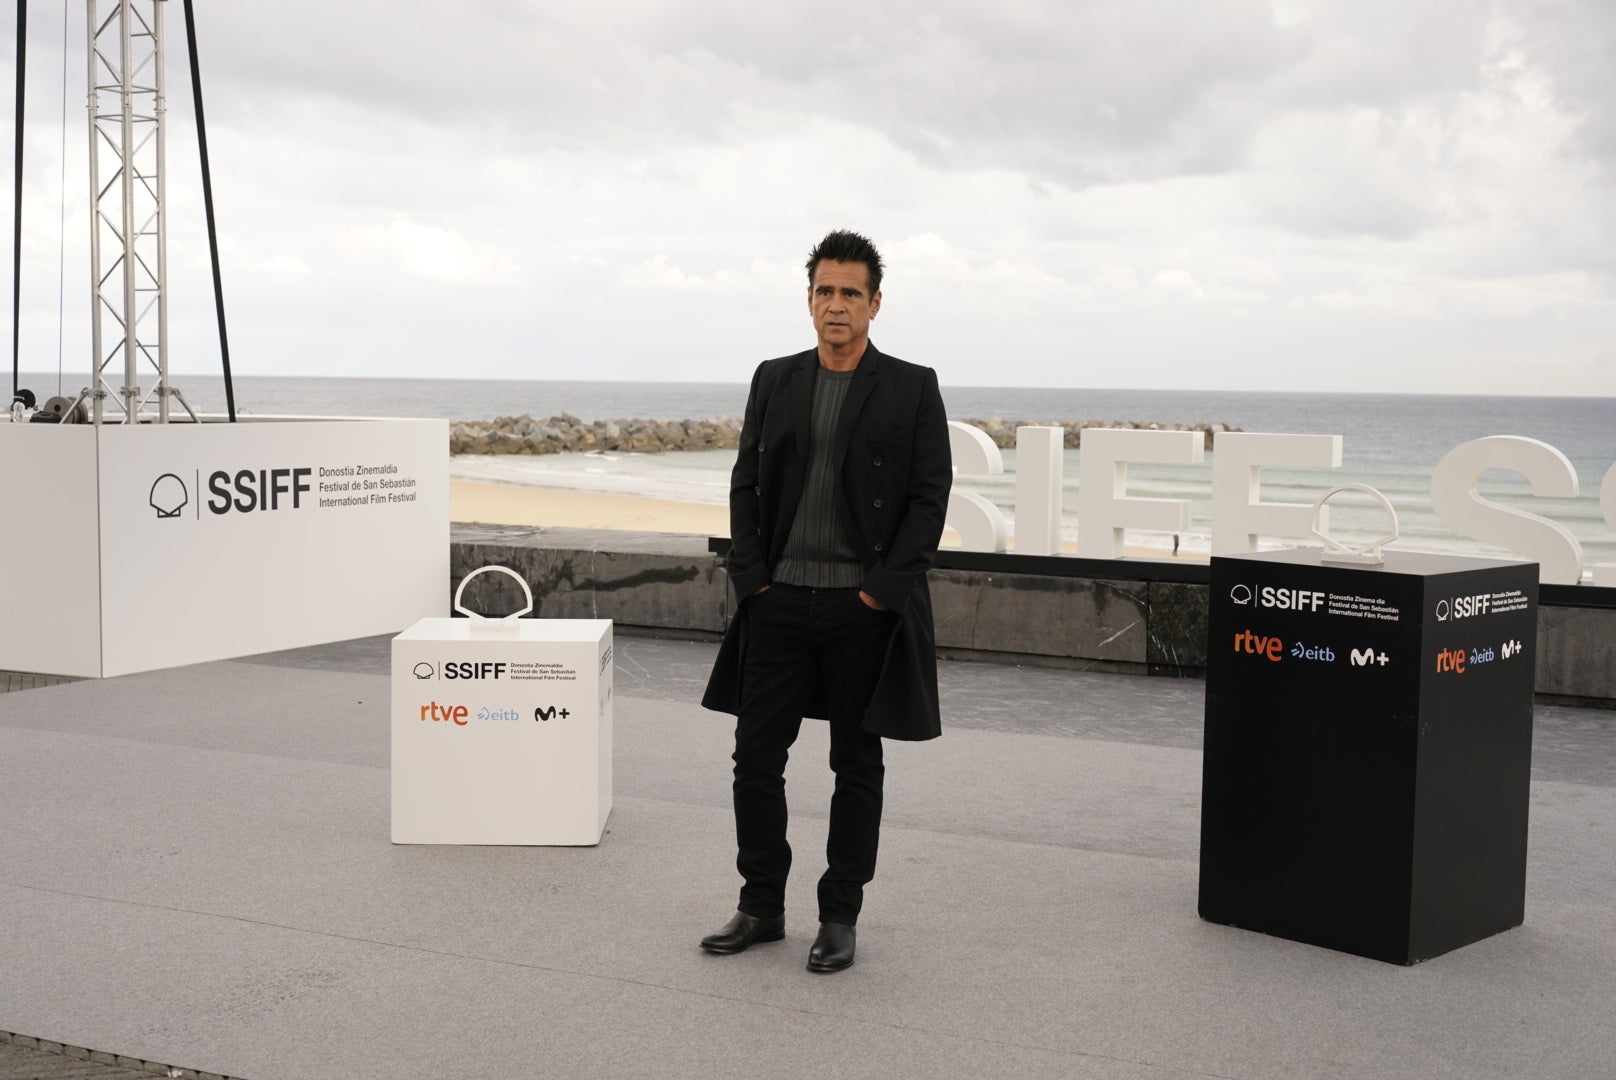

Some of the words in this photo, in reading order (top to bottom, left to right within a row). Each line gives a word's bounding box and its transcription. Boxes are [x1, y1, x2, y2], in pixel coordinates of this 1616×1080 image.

[319, 466, 355, 477] Donostia
[356, 464, 398, 476] Zinemaldia
[208, 468, 312, 515] SSIFF
[319, 481, 350, 492] Festival
[351, 481, 361, 490] de
[363, 479, 378, 489] San
[379, 478, 416, 489] Sebastián
[319, 495, 369, 507] International
[370, 494, 387, 504] Film
[388, 492, 416, 503] Festival
[1430, 434, 1616, 586] S
[1261, 586, 1325, 612] SSIFF
[1328, 600, 1350, 608] Festival
[1329, 593, 1354, 601] Donostia
[1454, 594, 1490, 618] SSIFF
[1328, 608, 1363, 618] International
[1376, 613, 1399, 622] Festival
[1234, 630, 1283, 661] rtve
[1307, 645, 1335, 662] eitb
[444, 662, 507, 680] SSIFF
[1436, 647, 1466, 674] rtve
[1477, 647, 1495, 663] eitb
[420, 701, 469, 726] rtve
[490, 707, 520, 721] eitb
